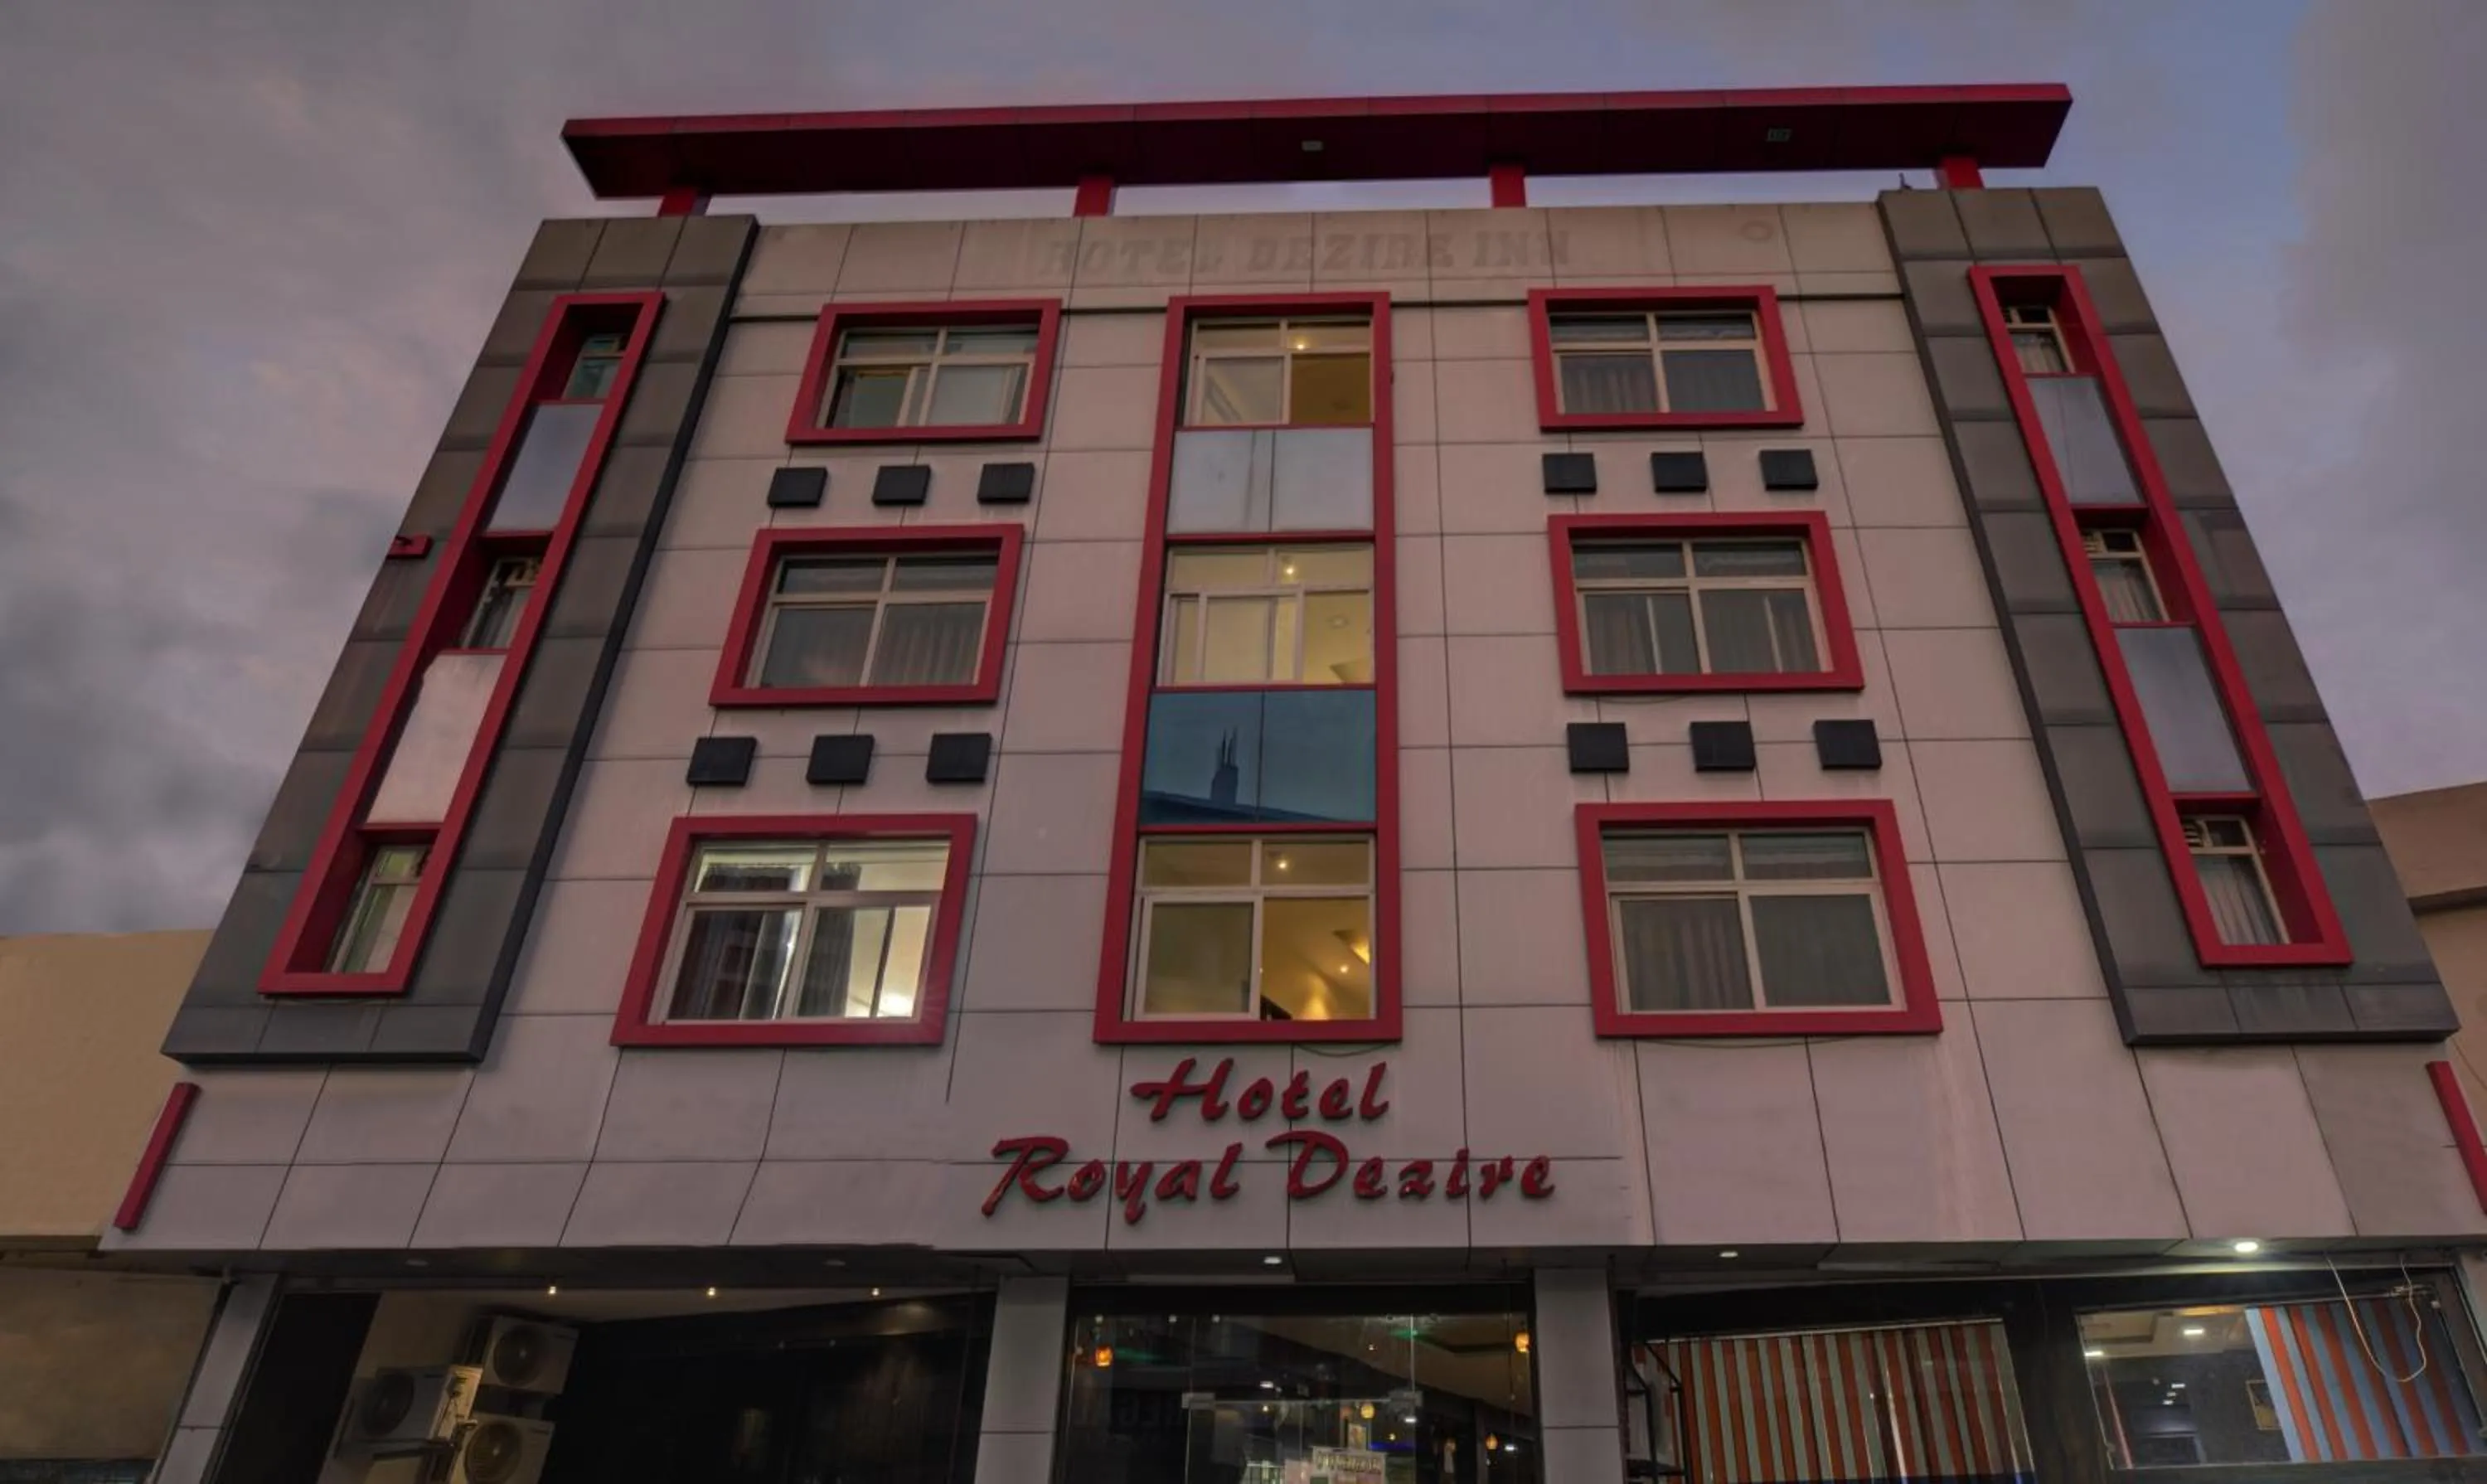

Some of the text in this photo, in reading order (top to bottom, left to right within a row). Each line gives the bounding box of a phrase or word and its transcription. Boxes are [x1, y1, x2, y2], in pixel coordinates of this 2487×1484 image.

[1471, 229, 1569, 268] INN
[1129, 1057, 1390, 1123] Hotel
[981, 1130, 1555, 1225] Royal Dezire
